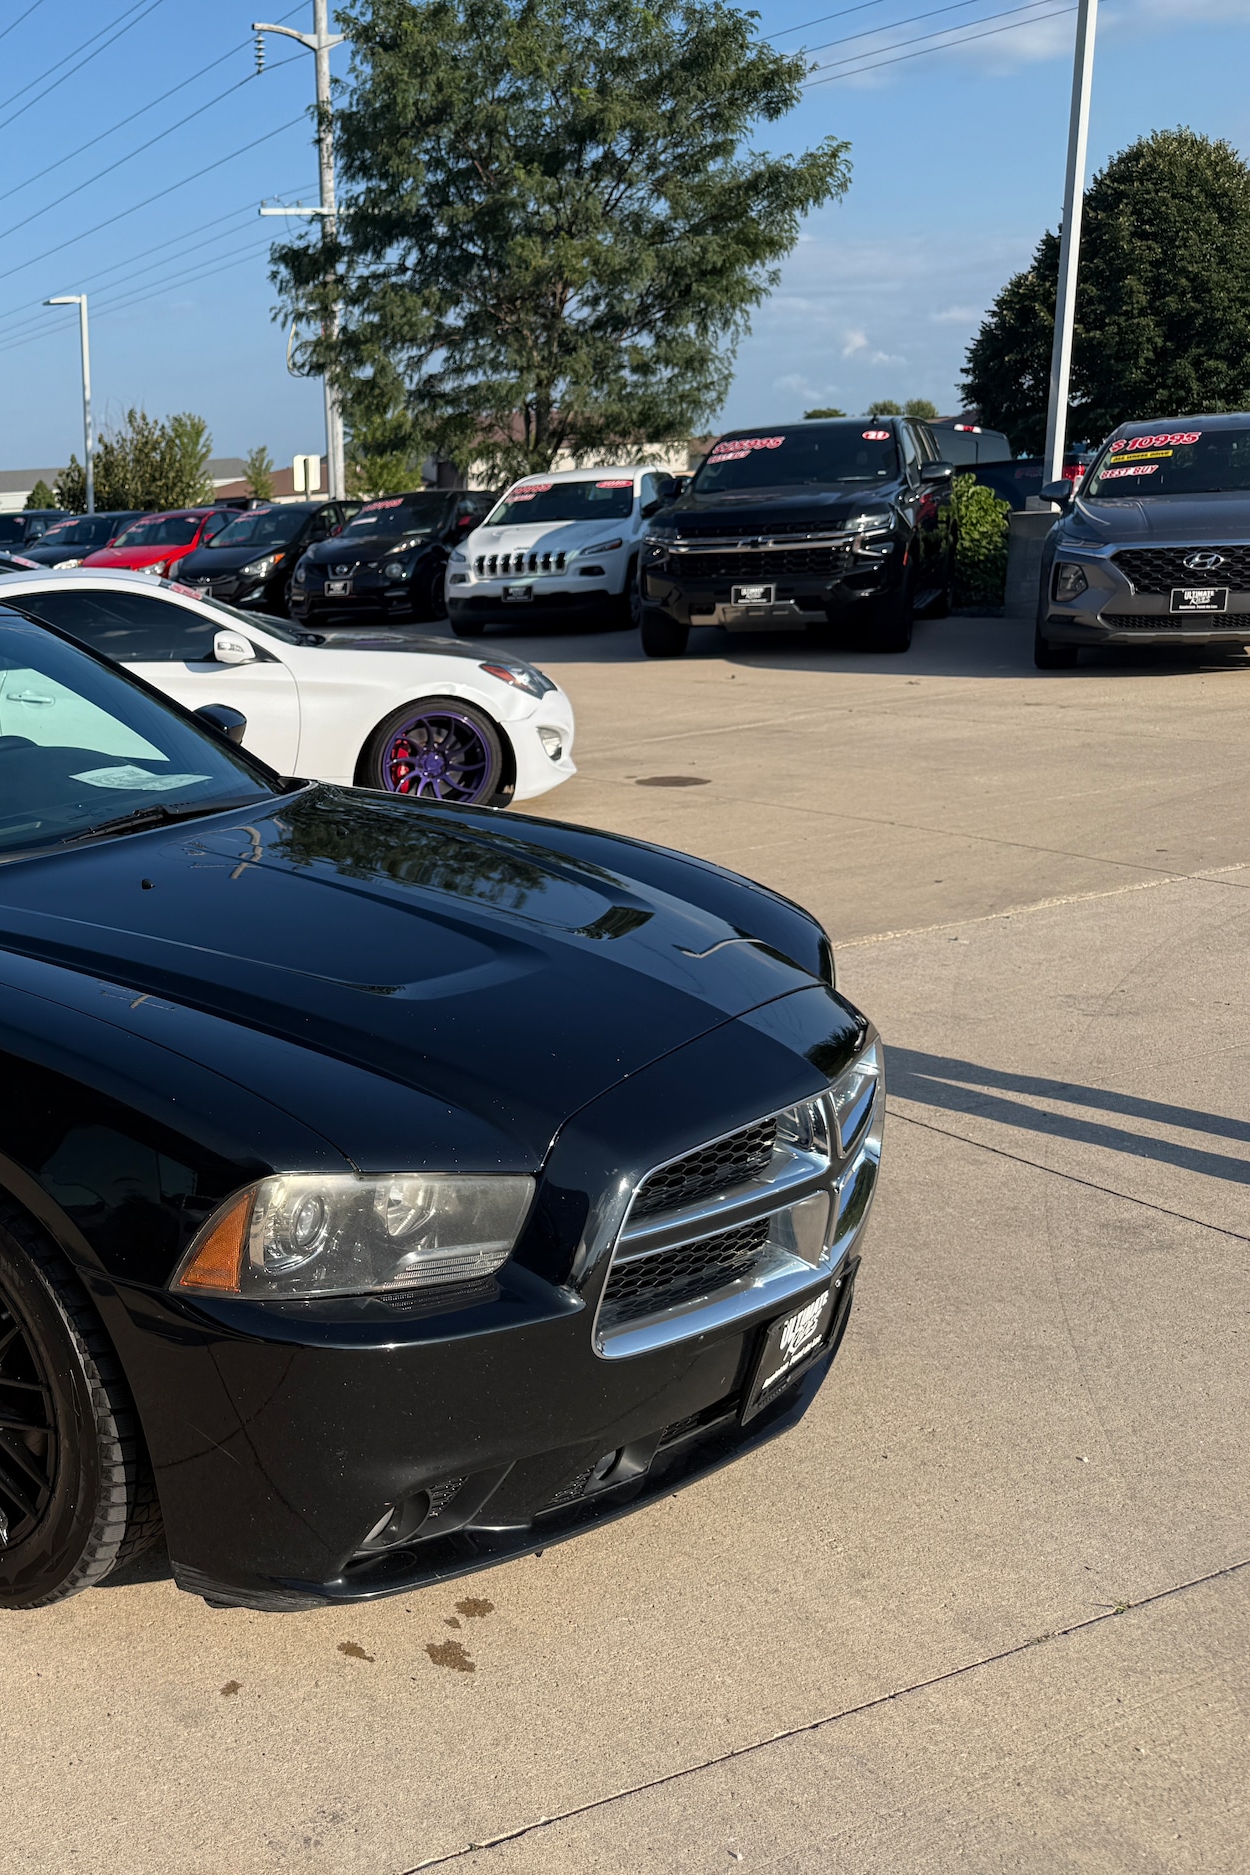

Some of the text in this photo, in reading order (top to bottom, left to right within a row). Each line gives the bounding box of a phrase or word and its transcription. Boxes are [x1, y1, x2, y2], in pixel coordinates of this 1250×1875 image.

[1109, 432, 1202, 453] $10995
[1100, 465, 1159, 480] BEST BUY
